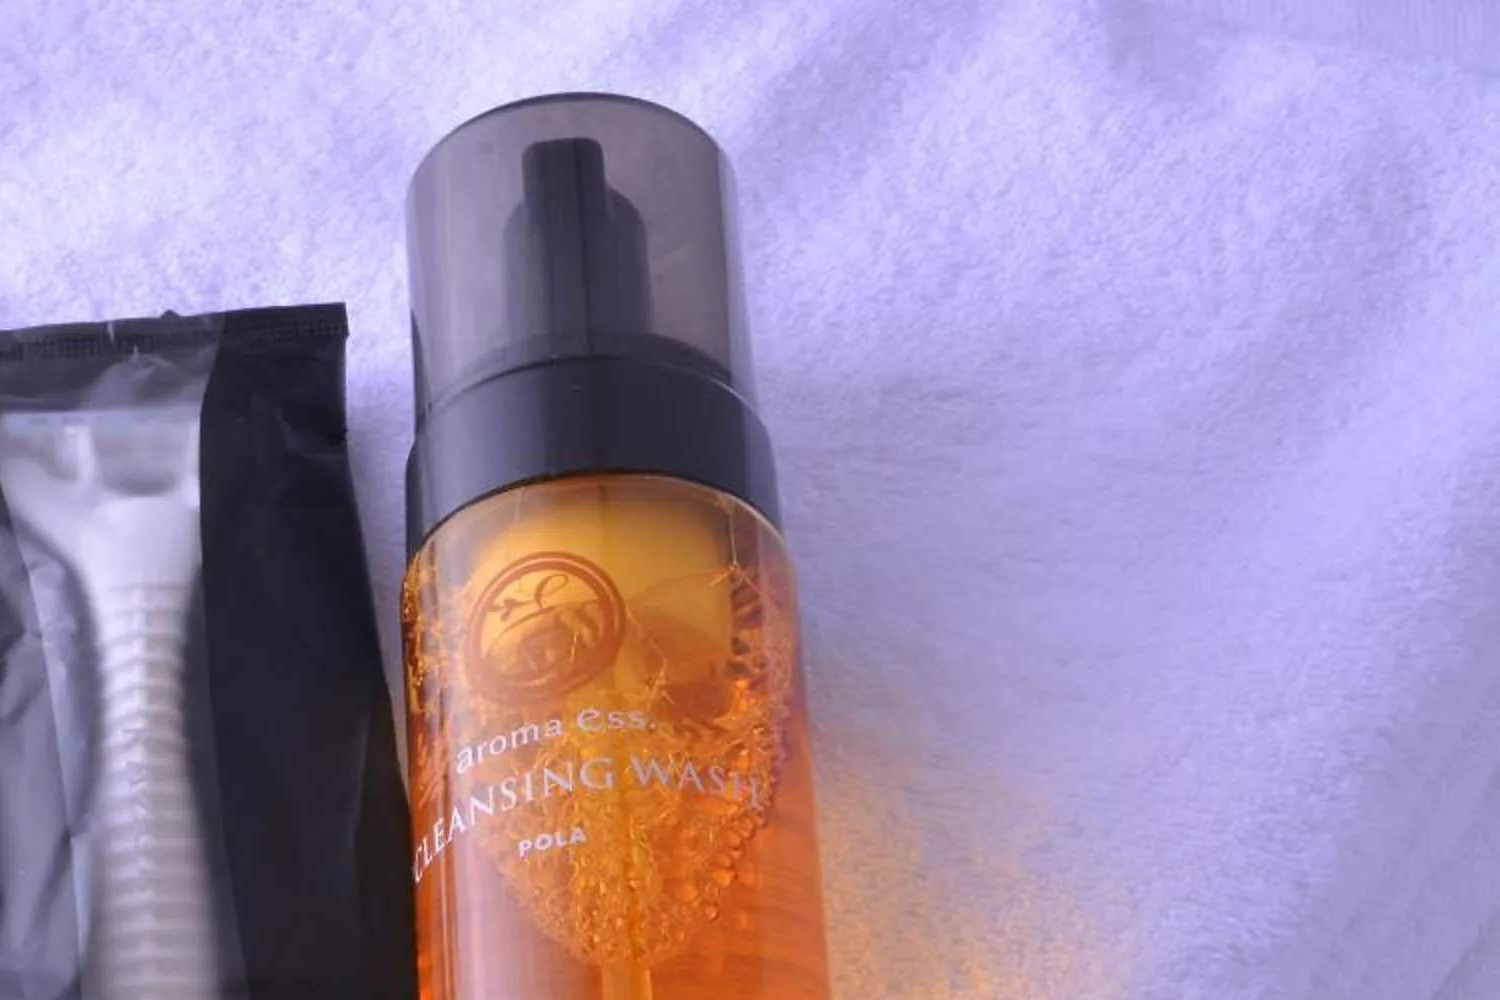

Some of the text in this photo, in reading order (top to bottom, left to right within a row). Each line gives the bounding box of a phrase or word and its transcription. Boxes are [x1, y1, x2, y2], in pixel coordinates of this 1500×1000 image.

[455, 718, 563, 775] aroma
[413, 757, 614, 883] CLEANSING
[518, 826, 587, 857] POLA
